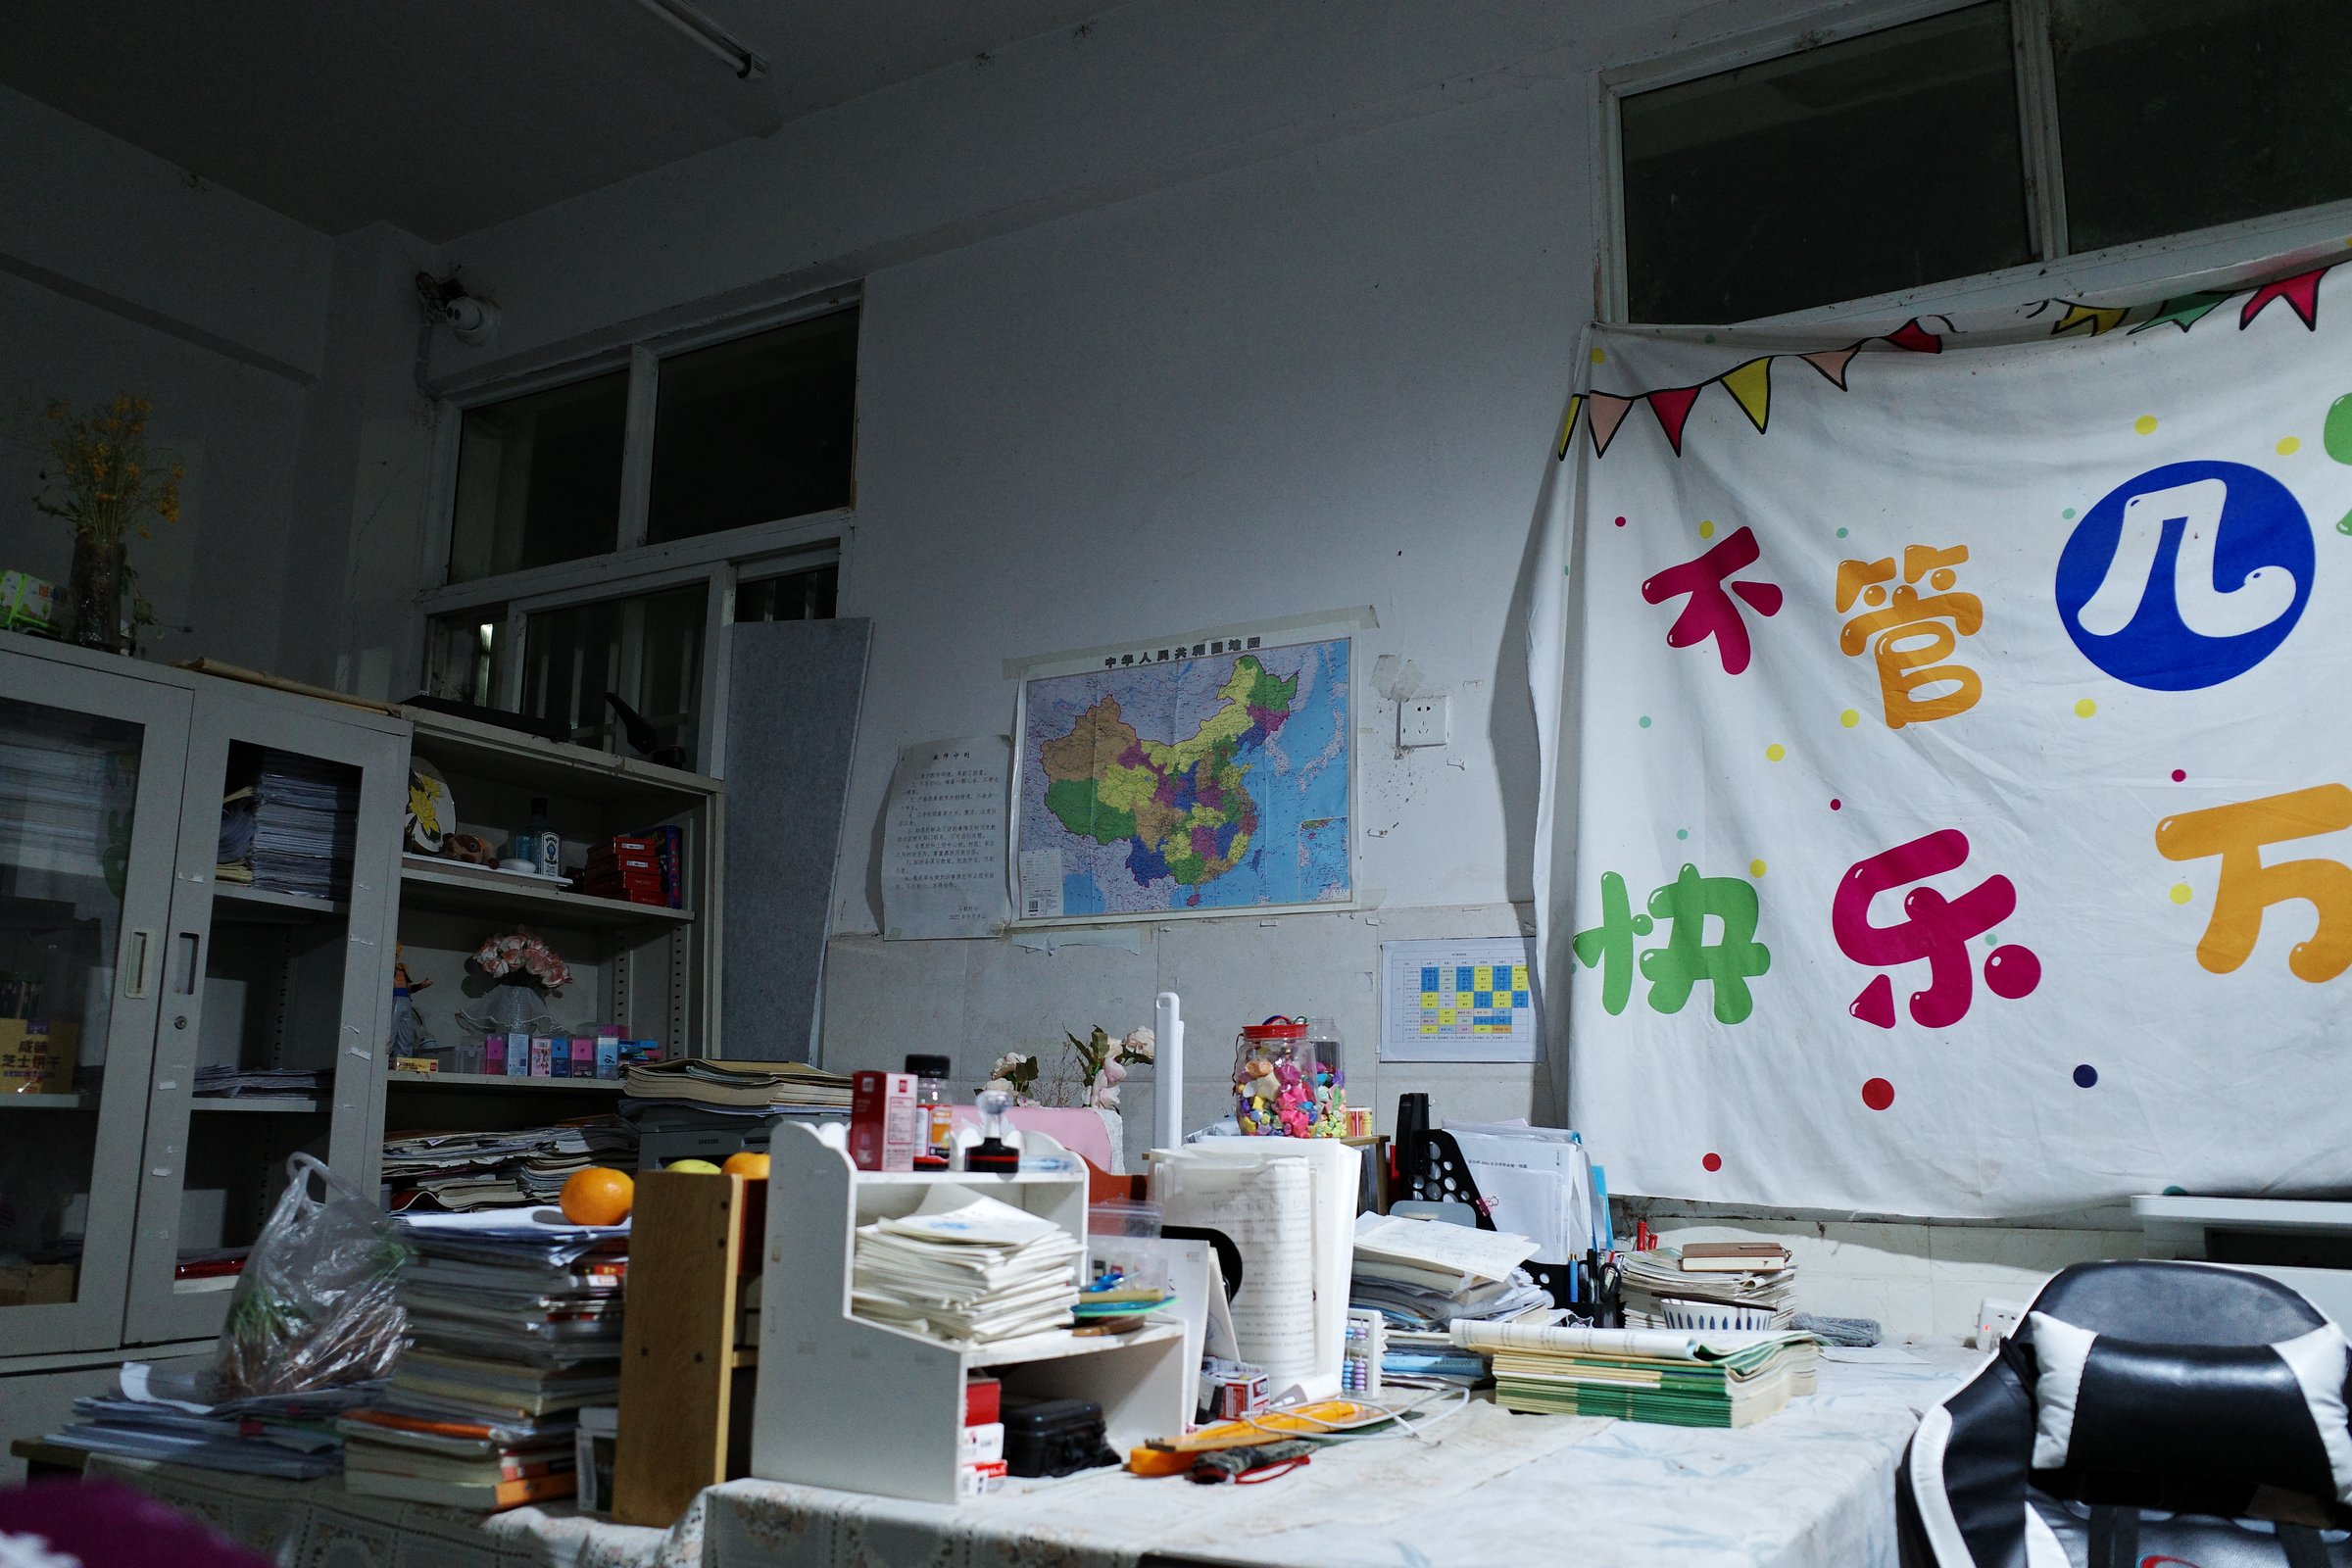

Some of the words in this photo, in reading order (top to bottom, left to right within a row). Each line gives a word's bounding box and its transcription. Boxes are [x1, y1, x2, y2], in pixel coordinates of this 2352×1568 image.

[1642, 394, 2352, 729] 不管几
[1104, 637, 1261, 668] 中华人民共和国地图
[1, 1054, 61, 1068] 芝士饼干
